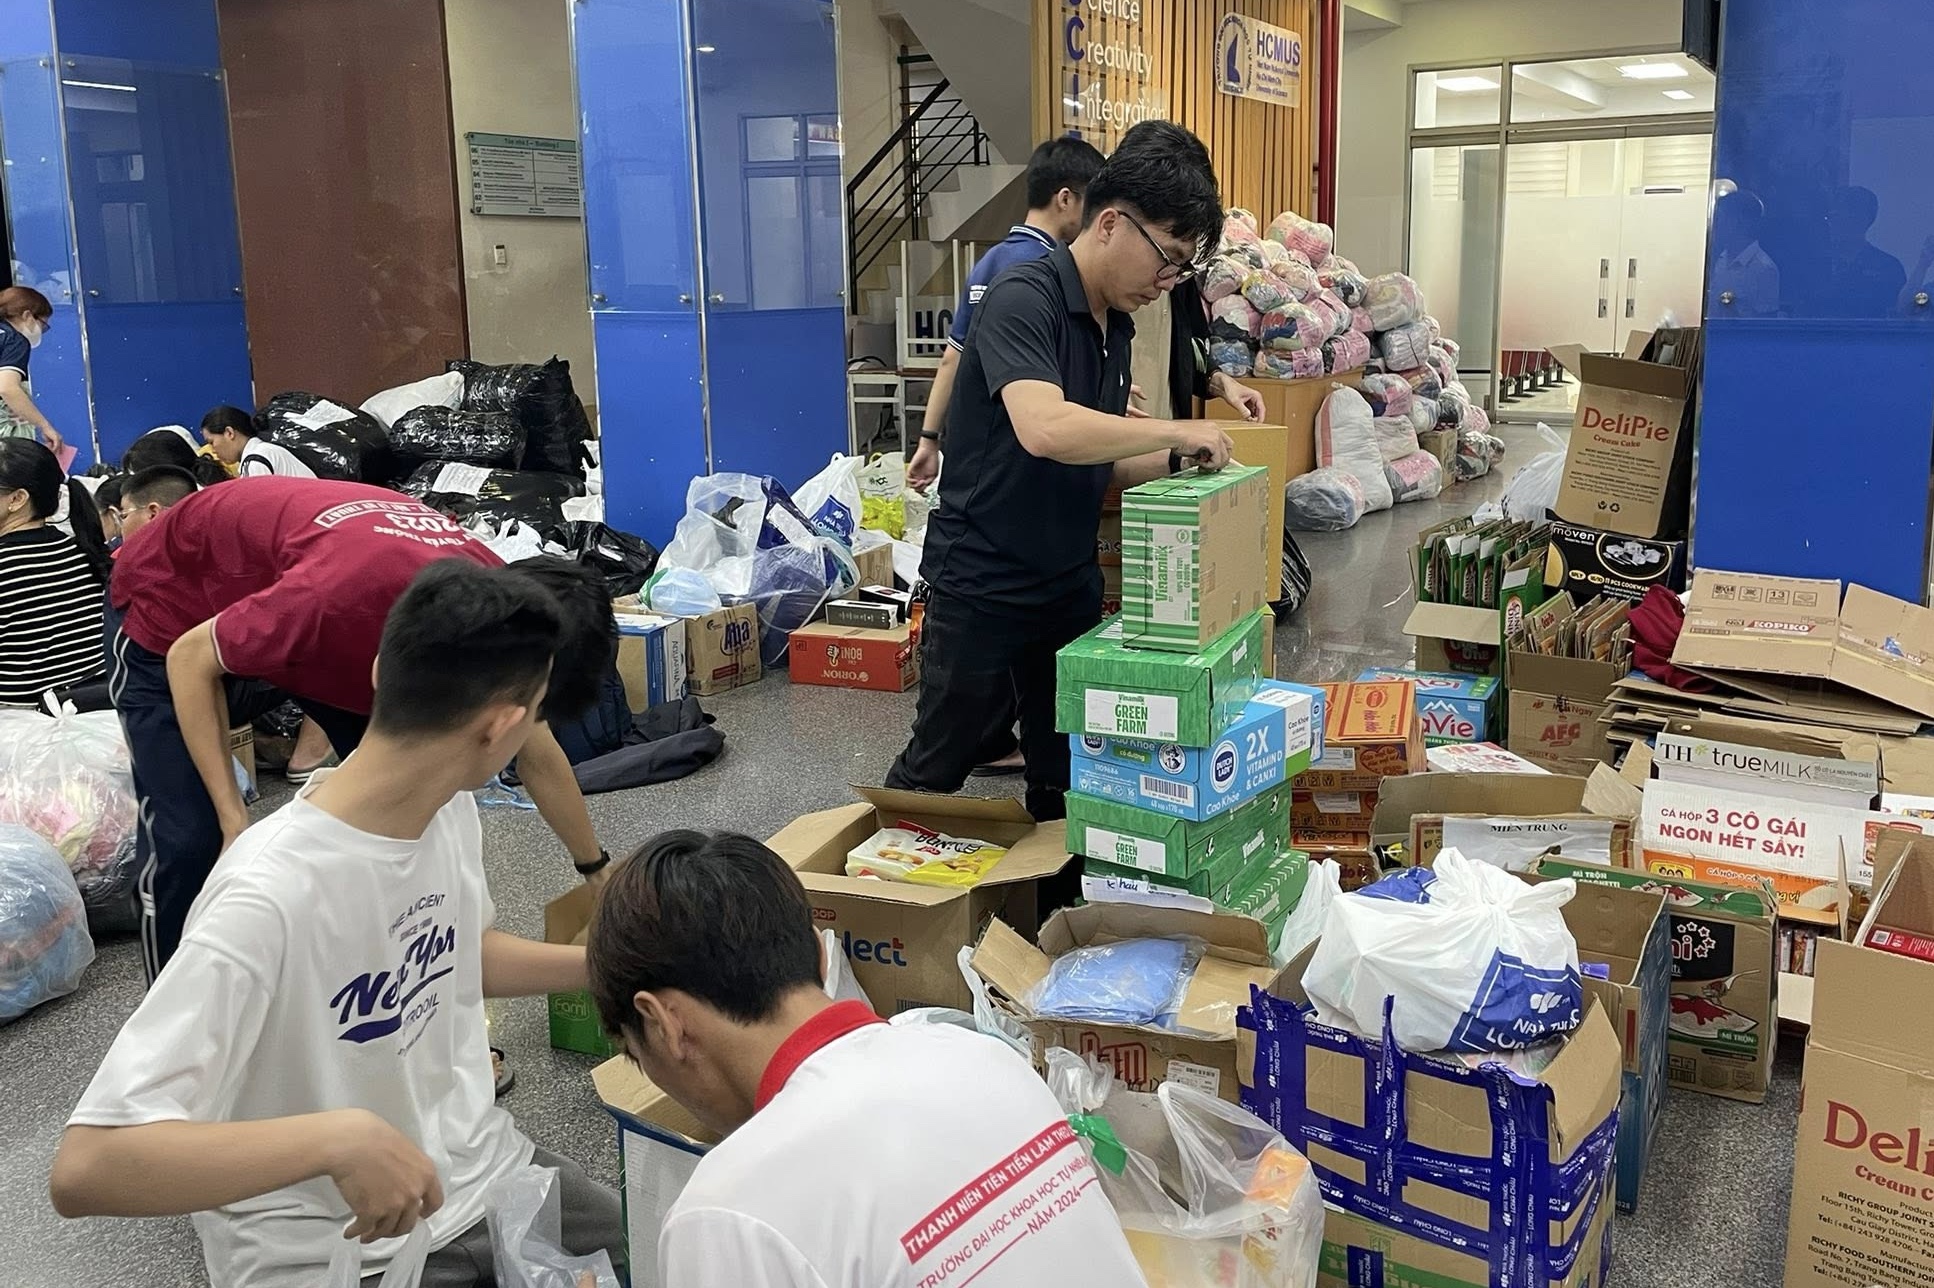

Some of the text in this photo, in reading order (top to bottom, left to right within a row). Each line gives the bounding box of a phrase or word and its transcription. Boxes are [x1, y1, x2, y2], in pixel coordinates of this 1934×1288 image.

[1070, 0, 1140, 22] cience
[1257, 29, 1301, 67] HCMUS
[1582, 407, 1670, 441] DeliPie
[385, 513, 460, 533] 2023
[1155, 545, 1169, 601] Vinamilk
[1621, 581, 1650, 592] COOKWAR
[1753, 621, 1810, 632] KOPIKO
[823, 670, 858, 680] ORION
[1115, 704, 1149, 721] GREEN
[1423, 711, 1474, 738] aVie
[1116, 719, 1147, 734] FARM
[1246, 725, 1269, 761] 2X
[1660, 743, 1692, 762] TH
[1216, 757, 1232, 770] DUTCH
[1218, 766, 1232, 777] LADY
[1246, 750, 1283, 775] VITAMIN D
[1253, 767, 1276, 787] CANXI
[1206, 802, 1221, 815] Cao
[1526, 823, 1568, 832] TRUNG
[1706, 809, 1719, 824] 3
[1726, 811, 1760, 831] CÔ
[1767, 817, 1806, 838] GÁI
[1115, 842, 1138, 856] GREEN
[1659, 824, 1713, 844] NGON
[1718, 831, 1757, 851] HẾT
[1116, 852, 1137, 867] FARM
[1572, 870, 1584, 878] MÌ
[843, 930, 908, 967] lect
[1824, 1099, 1934, 1177] Deli
[1855, 1164, 1917, 1198] cream
[905, 1208, 960, 1255] THANH
[956, 1187, 984, 1215] NIÊN
[980, 1168, 1009, 1195] TIÊN
[1004, 1150, 1033, 1178] TIẾN
[1030, 1136, 1056, 1160] LÀM
[1026, 1186, 1082, 1235] NĂM 2024
[1821, 1195, 1843, 1209] Floor
[1866, 1210, 1890, 1225] Richy
[1838, 1190, 1928, 1227] RICHY GROUP JOINT
[1899, 1201, 1933, 1219] Product
[916, 1165, 1071, 1288] TRƯỜNG ĐẠI HỌC KHOA HỌC TỰ
[1818, 1214, 1834, 1226] Tel:
[1835, 1220, 1857, 1234] (+84)
[1858, 1226, 1874, 1239] 243
[1874, 1233, 1891, 1246] 928
[1892, 1240, 1914, 1253] 4706
[1850, 1215, 1867, 1227] Cau
[1888, 1228, 1922, 1246] District,
[1808, 1243, 1830, 1257] Road
[1830, 1250, 1845, 1263] No.
[1854, 1259, 1878, 1275] Trang
[1878, 1268, 1901, 1283] Bang
[1811, 1235, 1838, 1251] RICHY
[1839, 1245, 1865, 1260] FOOD
[1866, 1255, 1917, 1279] SOUTHERN
[1812, 1265, 1829, 1278] Tel:
[1821, 1258, 1845, 1274] Trang
[1845, 1266, 1868, 1282] Bang
